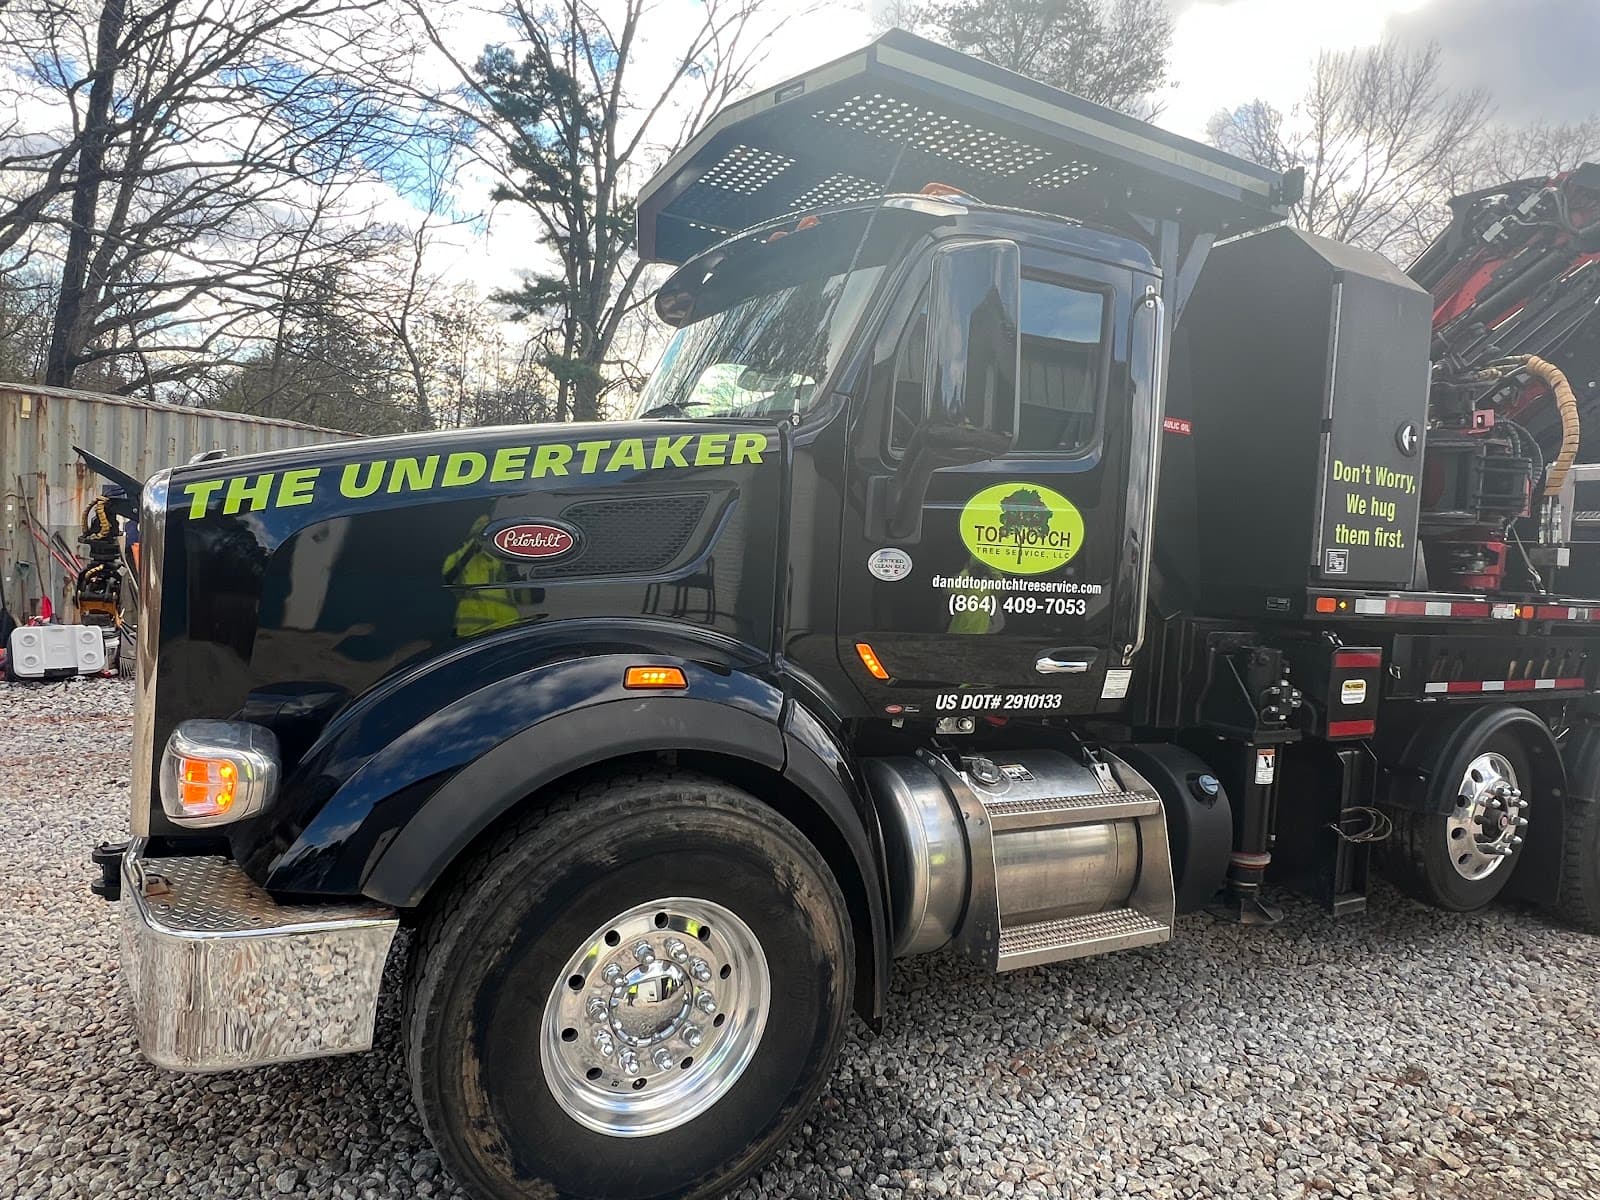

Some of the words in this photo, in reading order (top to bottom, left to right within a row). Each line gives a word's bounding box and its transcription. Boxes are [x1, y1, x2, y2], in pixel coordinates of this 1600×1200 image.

[183, 468, 321, 520] THE
[339, 433, 768, 499] UNDERTAKER
[1333, 460, 1371, 485] Don't
[1375, 465, 1416, 495] Worry,
[1346, 493, 1367, 515] We
[1370, 496, 1396, 522] hug
[503, 530, 566, 548] Peterbilt
[1335, 524, 1370, 546] them
[1374, 527, 1405, 549] first.
[976, 547, 1001, 555] TREE
[1005, 548, 1049, 559] SEVICE,
[932, 575, 1102, 594] danddtopnotchtreeservice.com
[948, 594, 997, 616] (864)
[1002, 597, 1086, 615] 409-7053
[935, 694, 958, 710] US
[960, 694, 1001, 710] DOT#
[1003, 693, 1063, 709] 2910133
